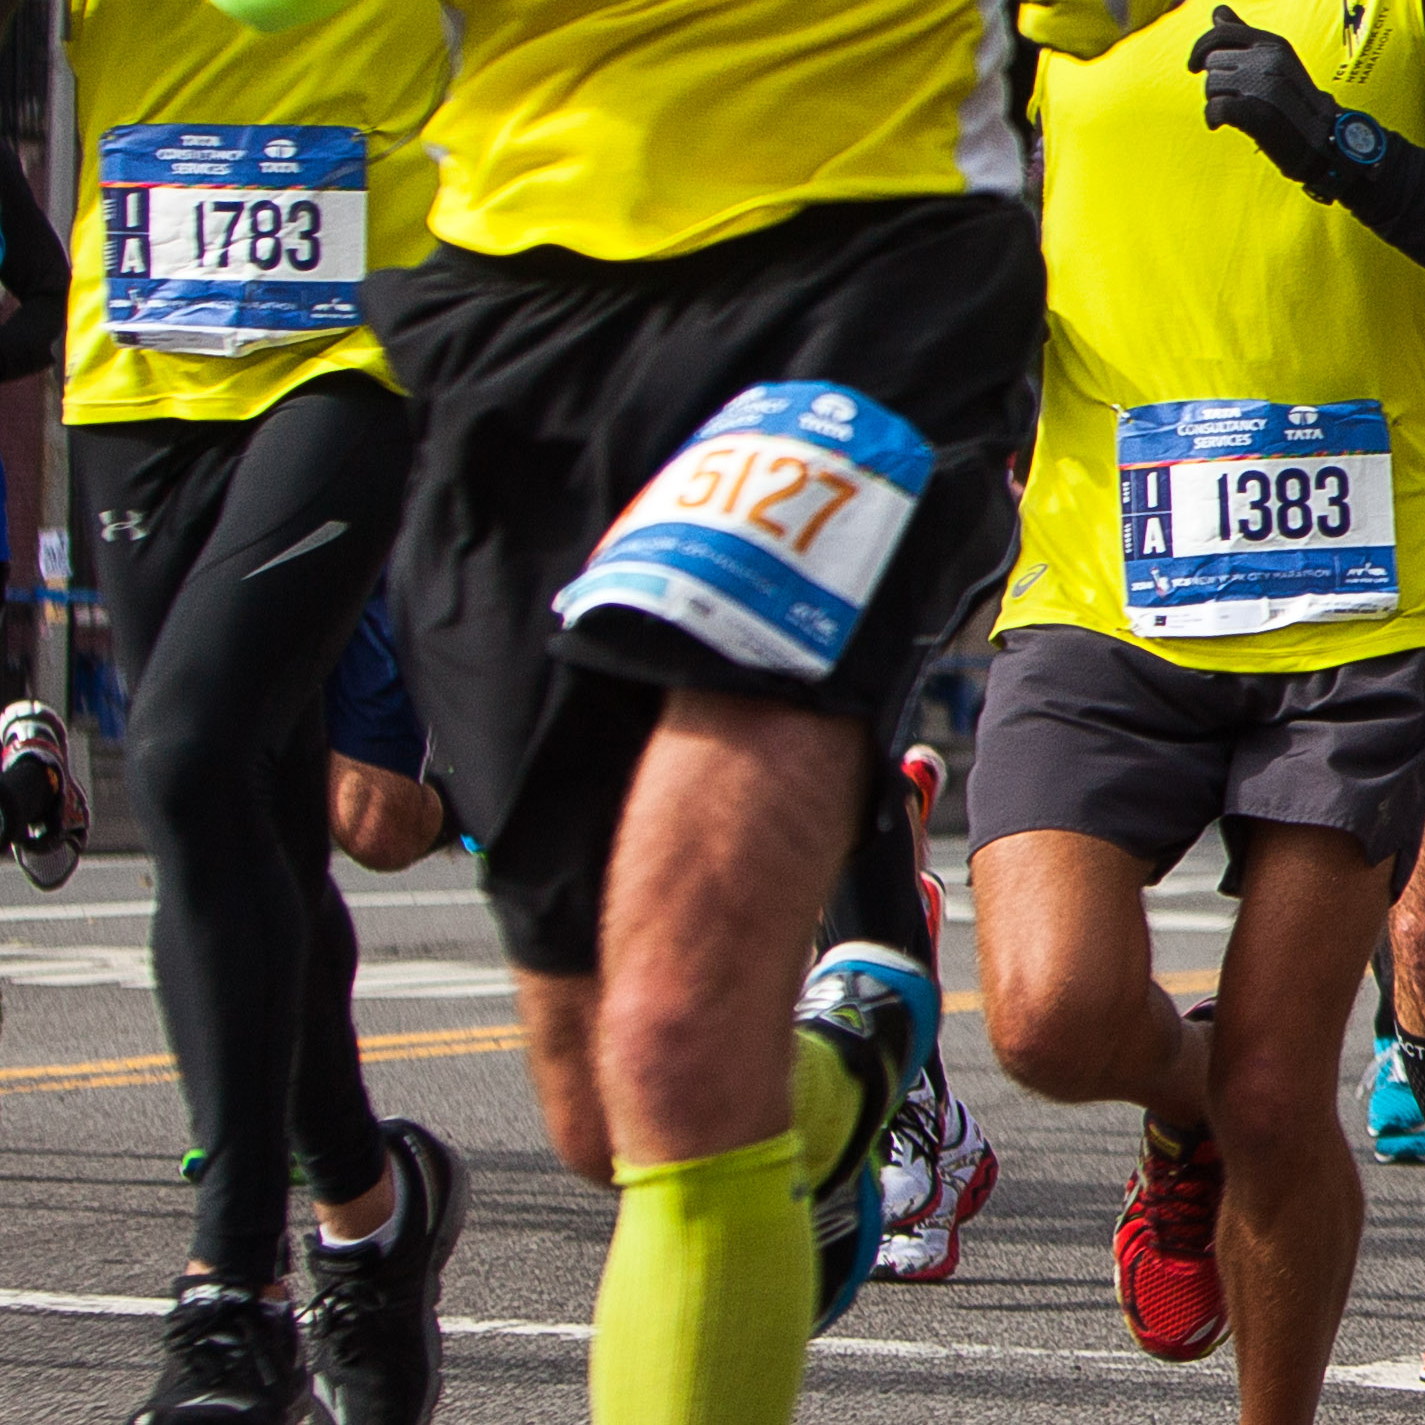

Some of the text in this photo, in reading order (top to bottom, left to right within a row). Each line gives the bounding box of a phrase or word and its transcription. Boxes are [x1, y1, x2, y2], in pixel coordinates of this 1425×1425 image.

[1345, 6, 1390, 83] NEW YORK CITY
[1357, 28, 1393, 85] MARATHON
[120, 238, 146, 274] A
[193, 199, 322, 272] 1783
[1176, 418, 1268, 437] CONSULTANCY
[1193, 433, 1253, 450] SERVICES
[1283, 428, 1325, 442] TATA
[676, 448, 859, 556] 5127
[1216, 465, 1351, 542] 1383
[1142, 517, 1168, 555] A
